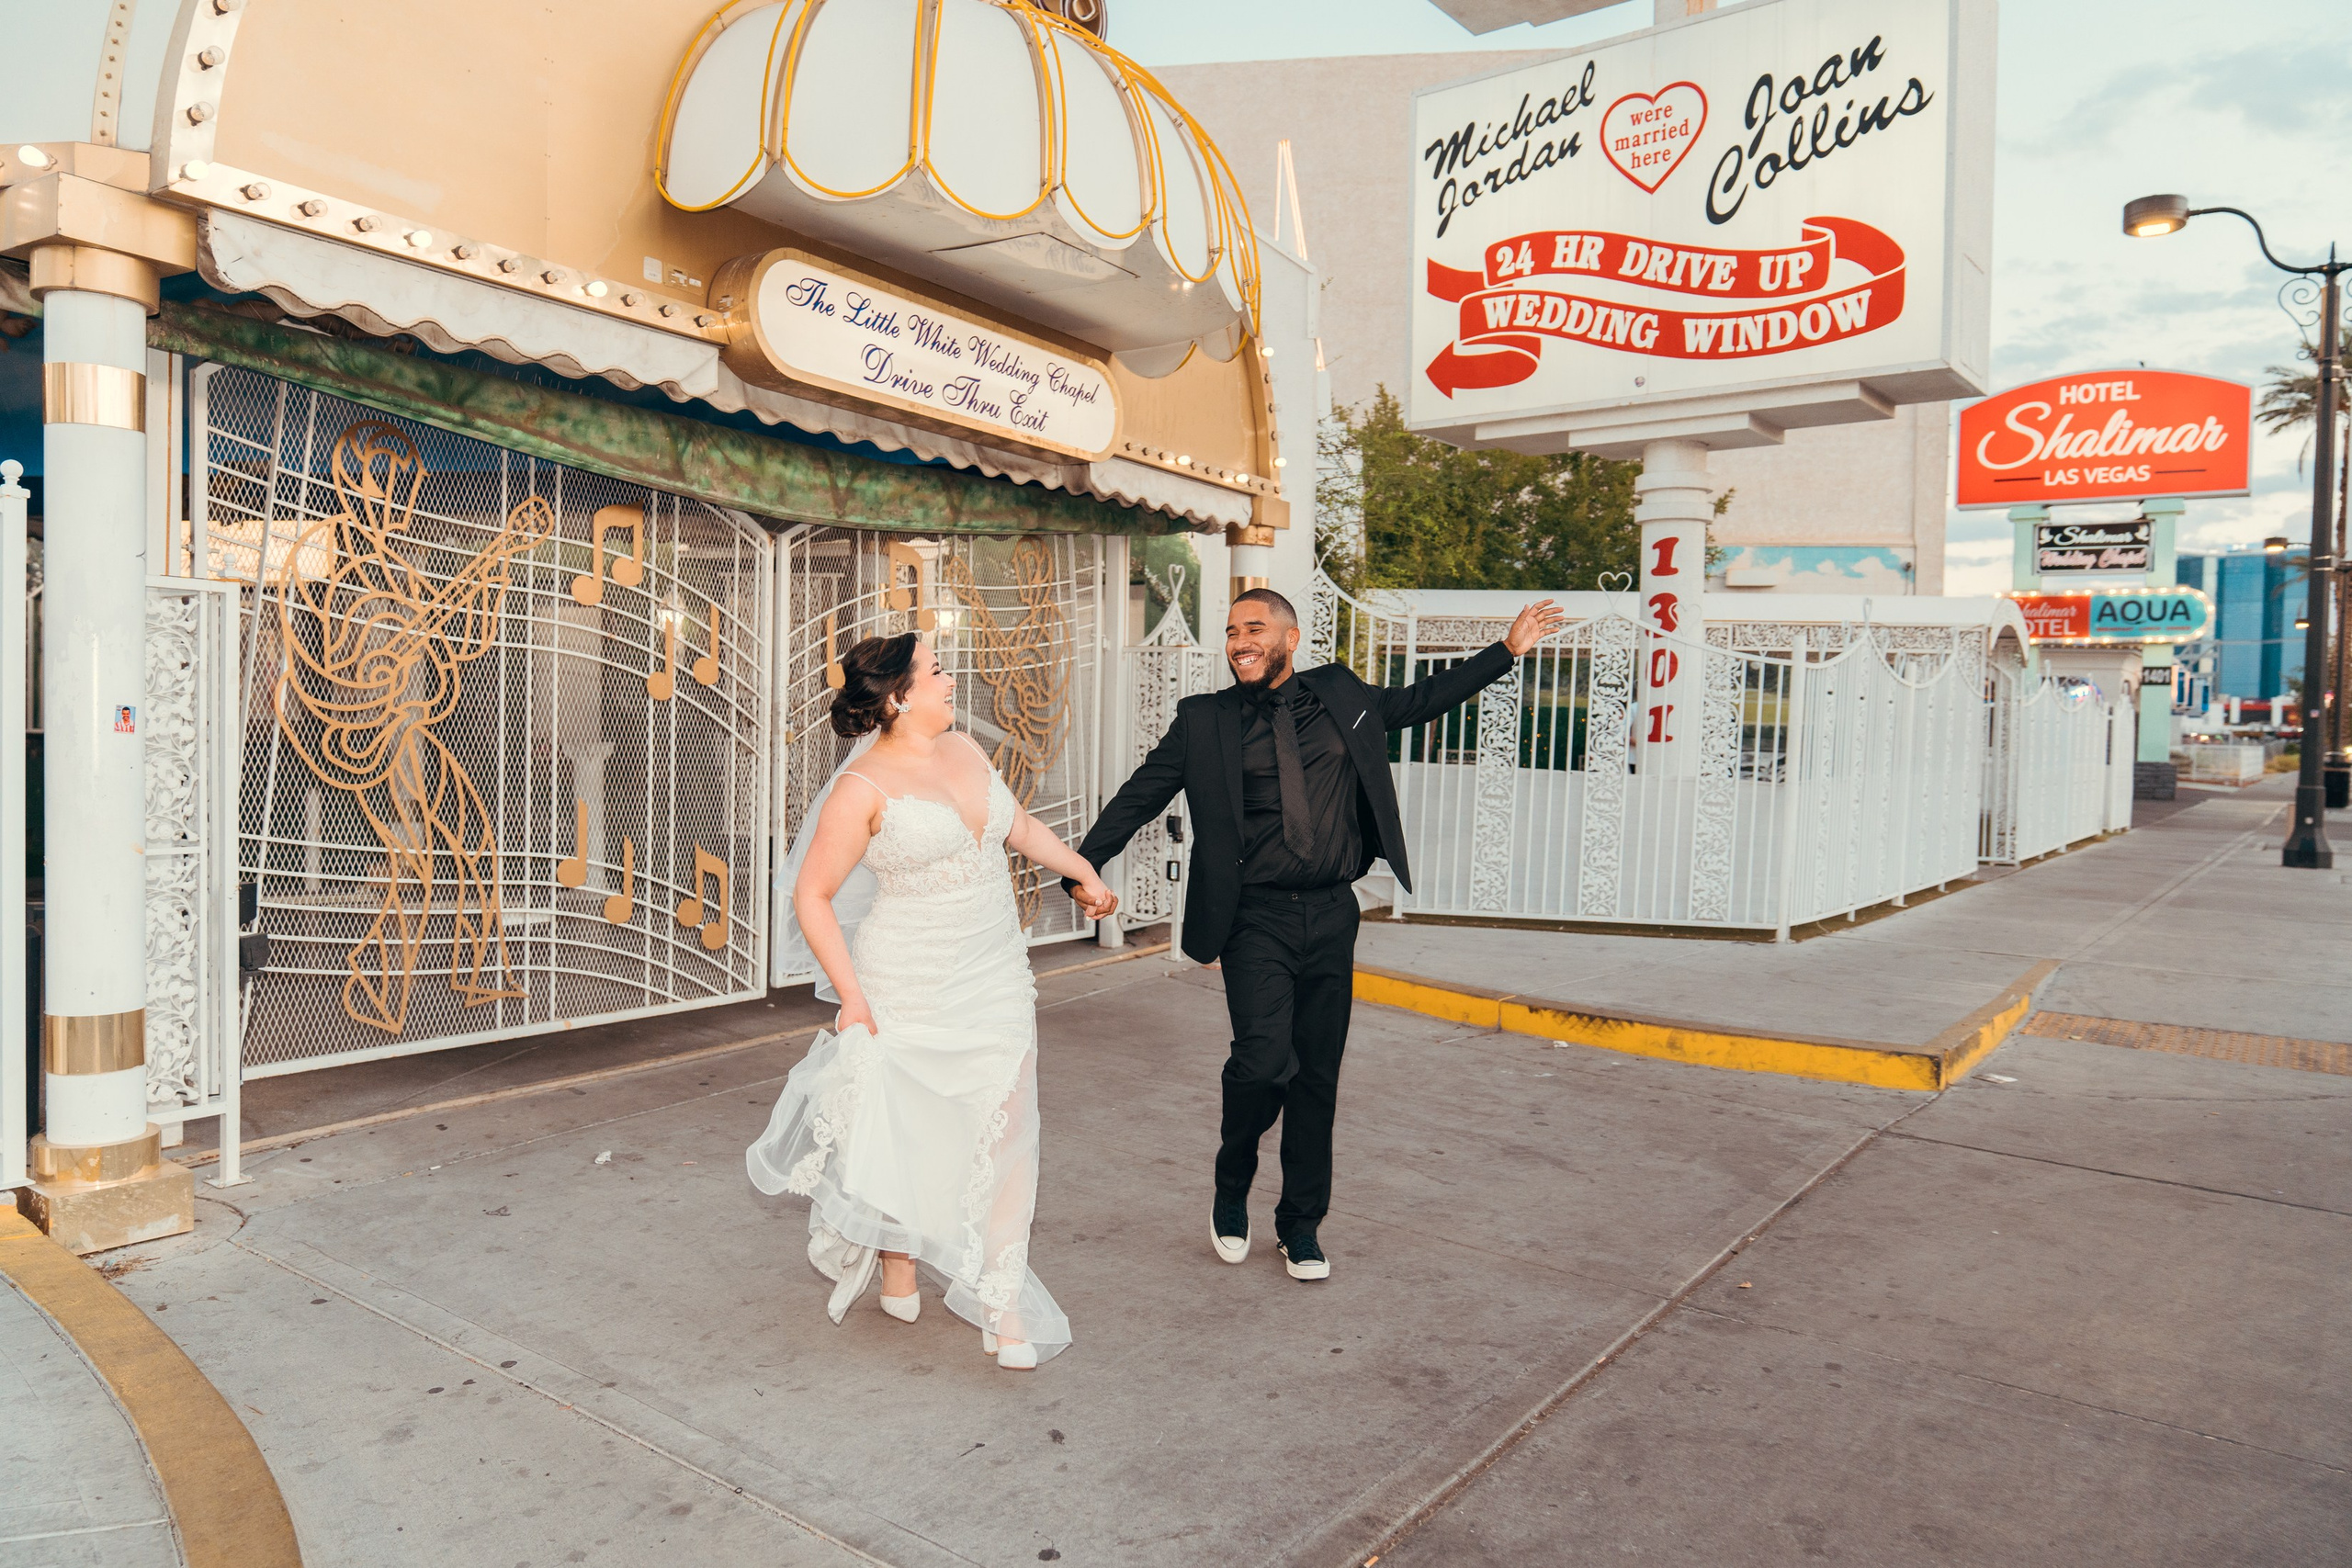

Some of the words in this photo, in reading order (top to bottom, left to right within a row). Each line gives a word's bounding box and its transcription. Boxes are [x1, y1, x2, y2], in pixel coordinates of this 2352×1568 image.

[1425, 60, 1596, 180] Michael
[1630, 102, 1673, 126] were
[1744, 35, 1886, 160] Joan
[1614, 118, 1690, 152] married
[1630, 145, 1672, 169] here
[1705, 78, 1934, 225] Collins
[1437, 131, 1582, 239] Jordan
[1495, 240, 1535, 277] 24
[1551, 234, 1601, 271] HR
[1619, 243, 1738, 292] DRIVE
[1758, 251, 1814, 291] UP
[786, 277, 836, 317] The
[842, 291, 900, 339] Little
[908, 314, 962, 360] White
[967, 335, 1040, 395] Wedding
[1046, 362, 1101, 407] Chapel
[1482, 294, 1660, 351] WEDDING
[1683, 289, 1872, 355] WINDOW
[861, 344, 934, 400] Drive
[943, 376, 1001, 420] Thru
[1010, 389, 1049, 432] Exit
[2060, 380, 2142, 405] HOTEL
[1976, 400, 2229, 470] Shalimar
[2044, 468, 2080, 486] LAS
[2083, 465, 2152, 485] VEGAS
[2053, 525, 2133, 547] Shalimar
[2015, 599, 2078, 618] halimar
[2096, 600, 2192, 626] AQUA
